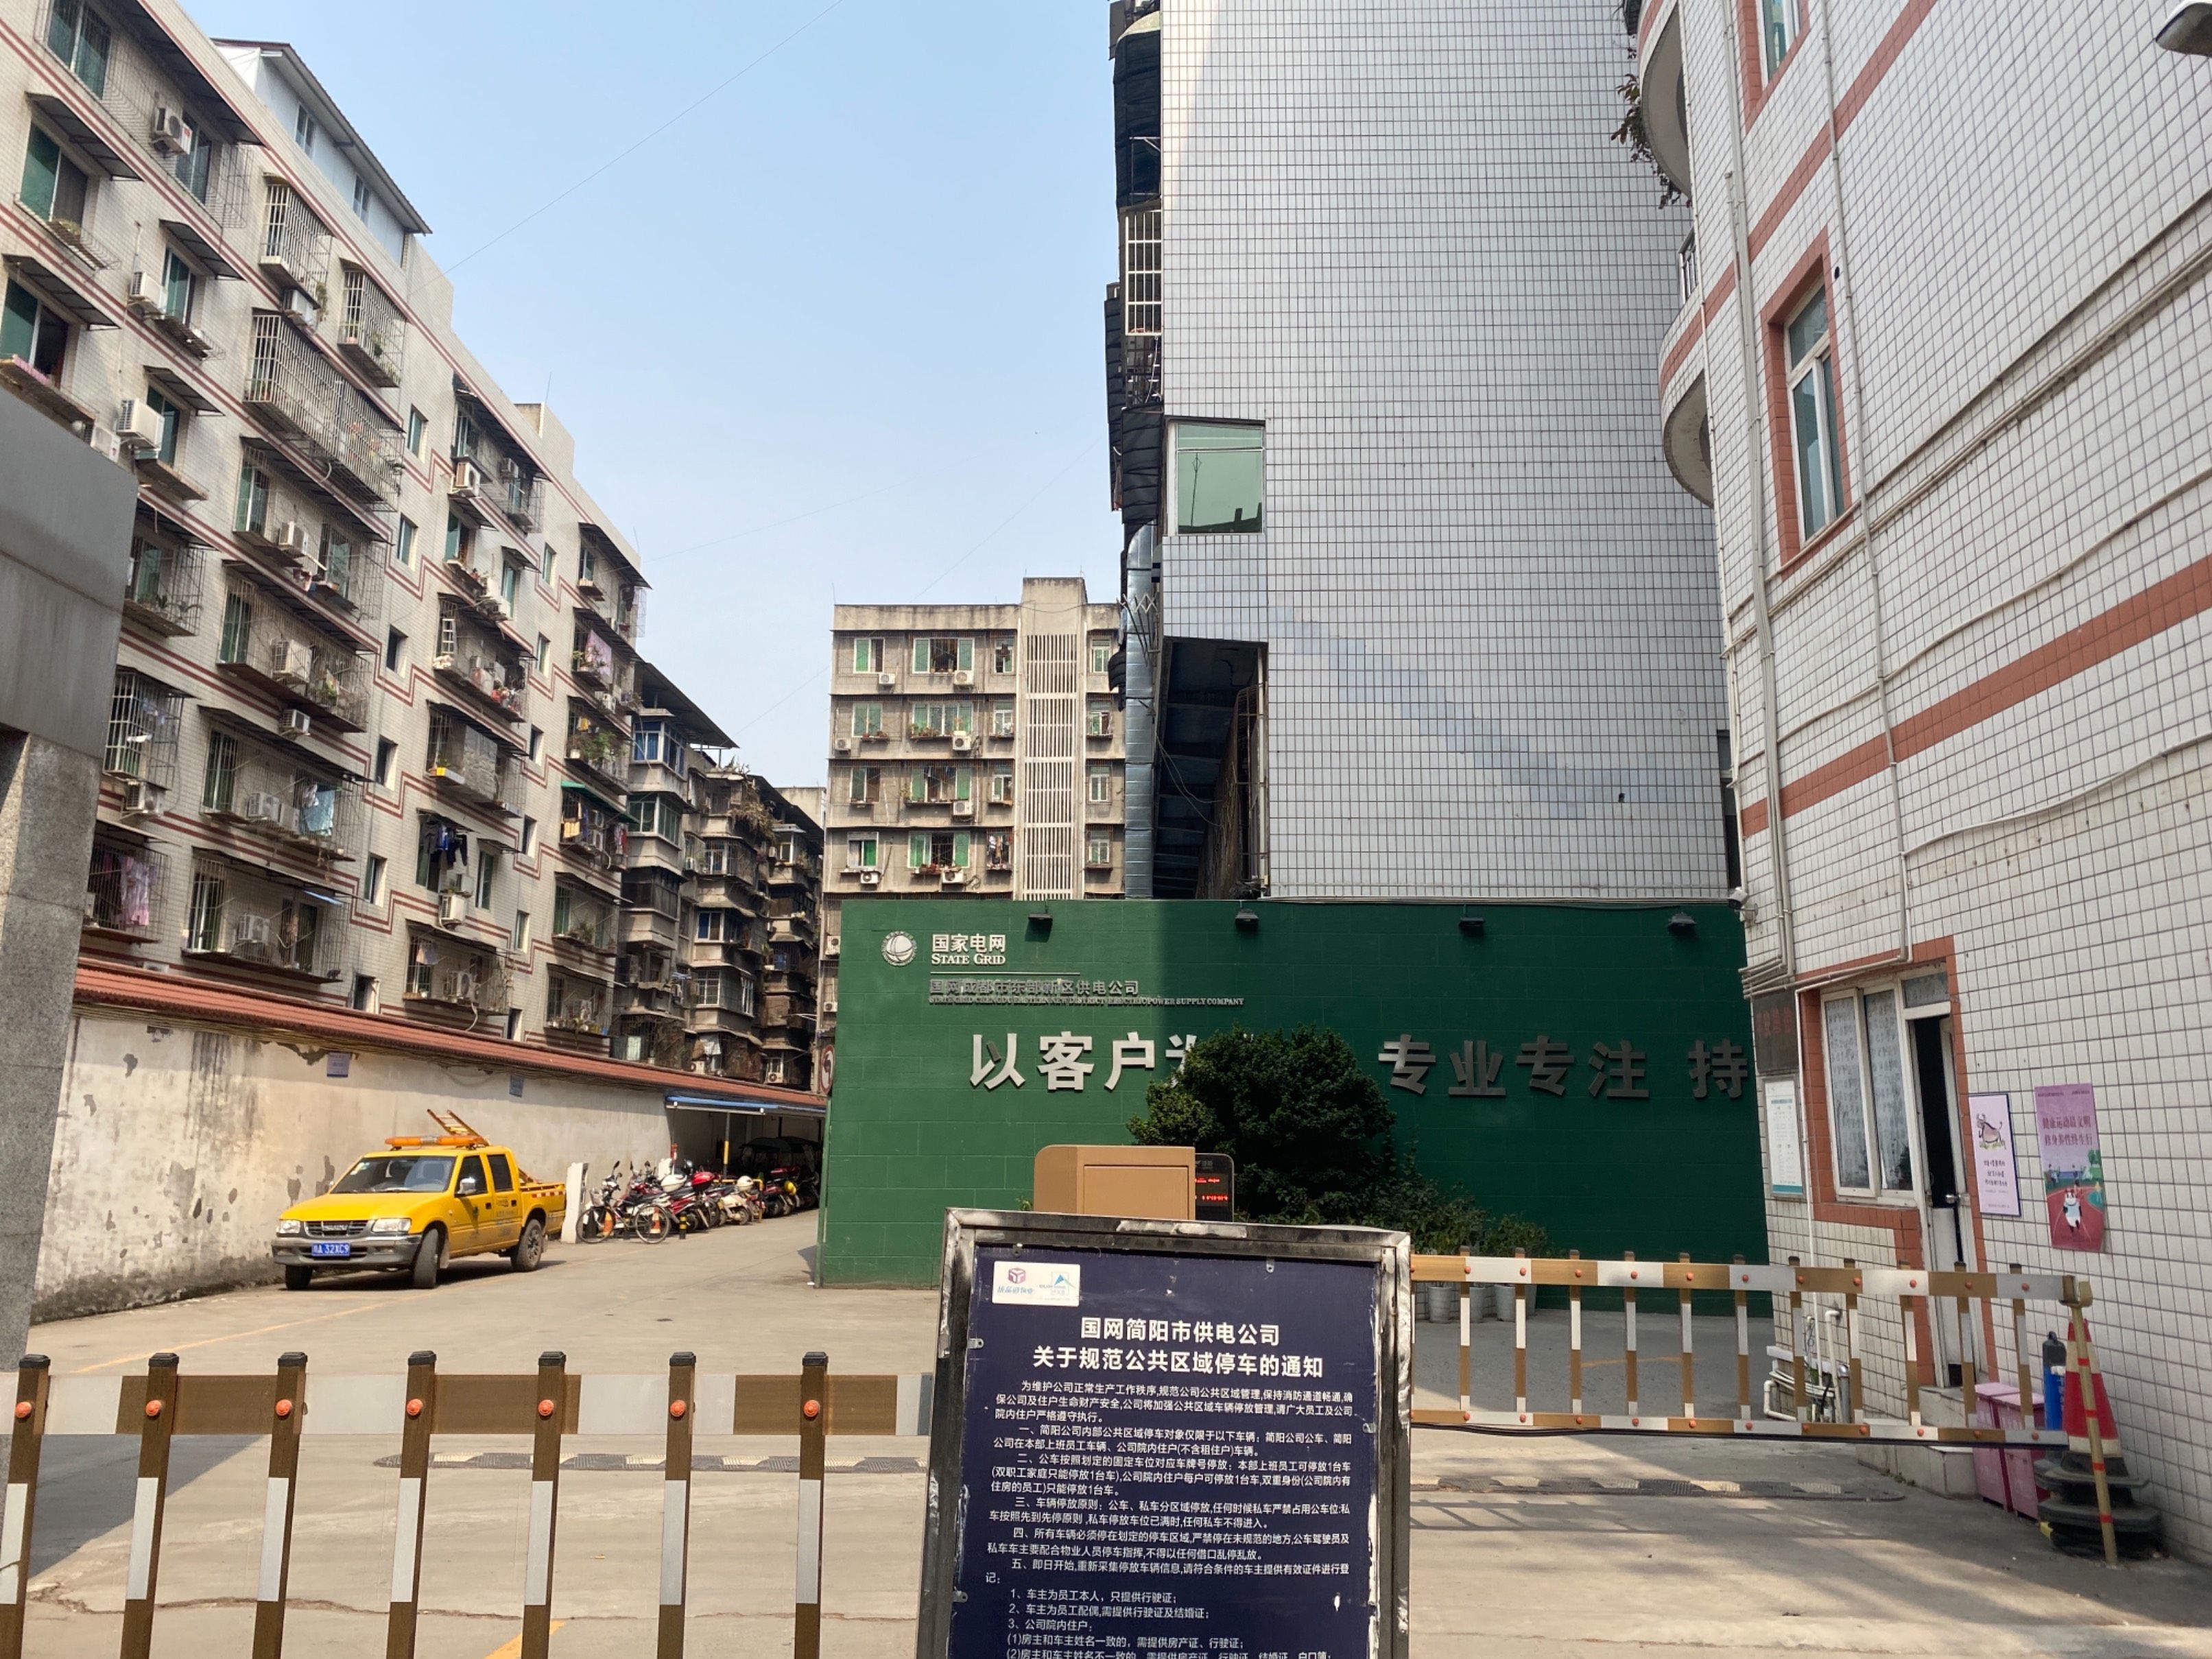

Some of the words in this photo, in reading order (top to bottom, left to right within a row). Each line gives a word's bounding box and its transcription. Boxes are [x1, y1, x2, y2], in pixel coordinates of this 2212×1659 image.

[932, 933, 1006, 953] 国家电网
[931, 953, 970, 965] STATE
[973, 953, 1006, 965] GRID
[931, 979, 1139, 995] 国网成都市东部新区供电公司
[1176, 997, 1206, 1005] SUPPLY
[1207, 998, 1244, 1006] COMPANY
[1378, 1034, 1650, 1099] 专业专注
[1687, 1038, 1748, 1099] 持
[1081, 1316, 1280, 1346] 国网简阳市供电公司
[1033, 1345, 1324, 1378] 关于规范公共区域停车的通知
[995, 1409, 1103, 1423] 院内住户严格遵守执行。
